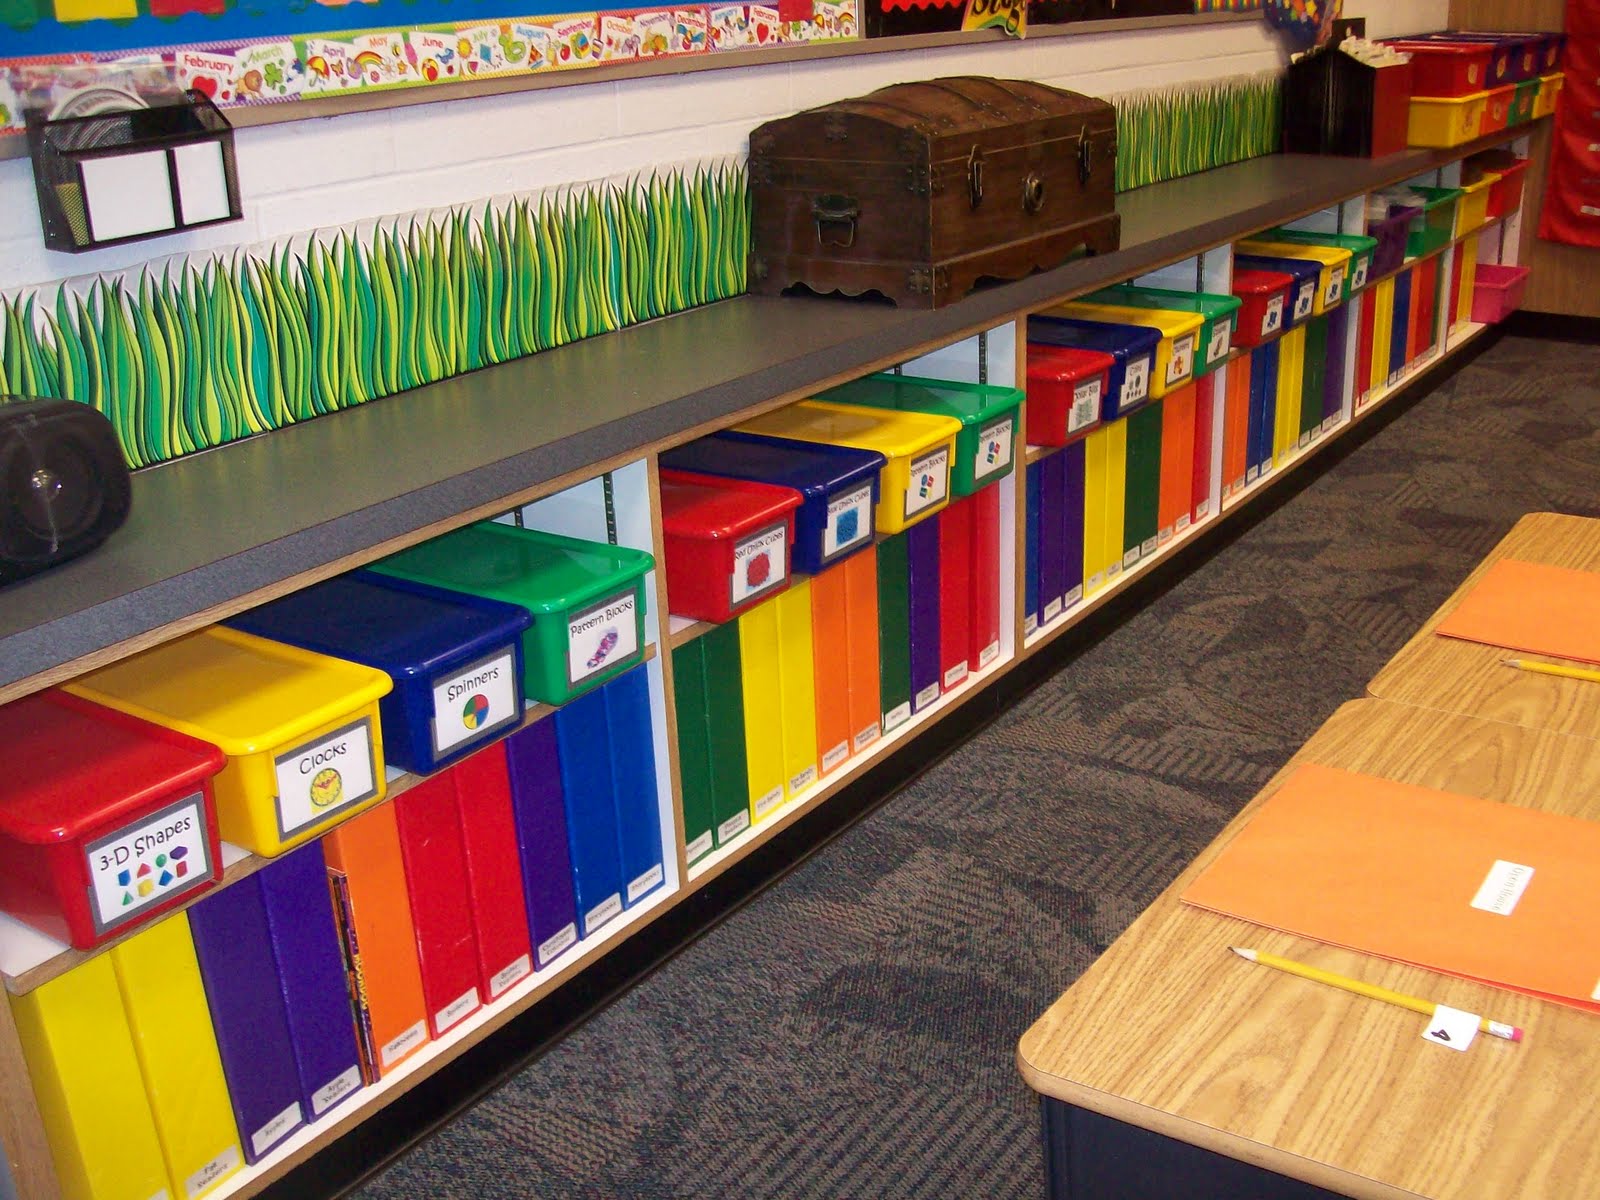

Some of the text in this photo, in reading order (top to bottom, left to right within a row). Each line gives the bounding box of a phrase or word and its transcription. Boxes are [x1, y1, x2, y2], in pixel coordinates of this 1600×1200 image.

[473, 30, 489, 43] July
[515, 26, 546, 40] August
[556, 20, 593, 38] September
[369, 36, 389, 48] May
[422, 36, 444, 49] June
[249, 46, 284, 63] March
[323, 44, 346, 59] April
[184, 54, 235, 74] February
[570, 600, 634, 638] Pattern Blocks
[447, 666, 500, 703] Spinners
[299, 742, 347, 775] Clocks
[100, 817, 191, 871] 3-D Shapes
